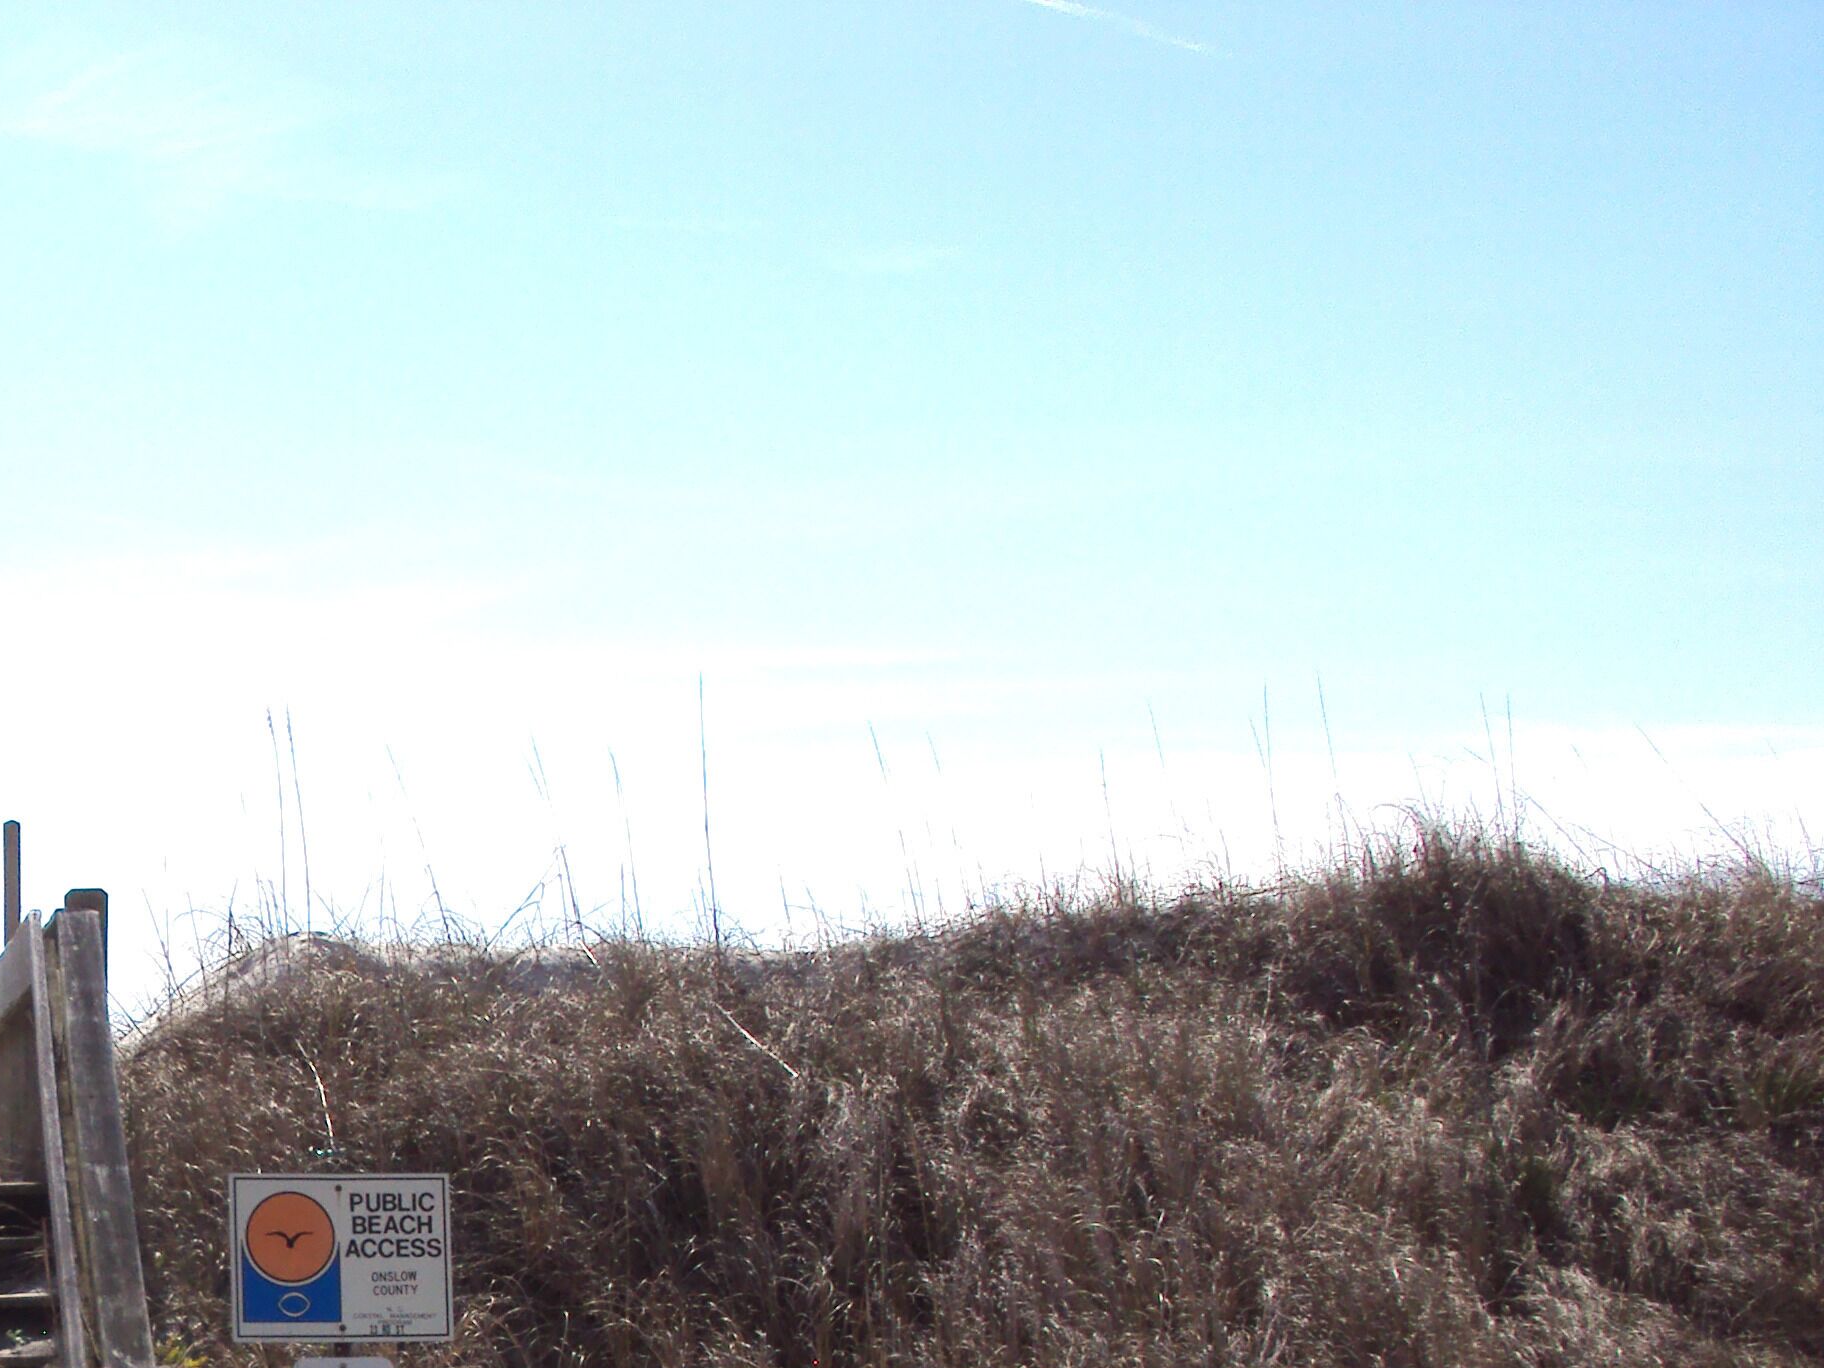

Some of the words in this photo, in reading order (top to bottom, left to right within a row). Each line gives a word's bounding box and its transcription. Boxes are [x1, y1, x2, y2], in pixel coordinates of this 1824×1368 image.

[348, 1191, 436, 1213] PUBLIC
[351, 1214, 433, 1235] BEACH
[345, 1237, 442, 1258] ACCESS
[370, 1270, 418, 1282] ONSLOW
[372, 1284, 419, 1296] COUNTY
